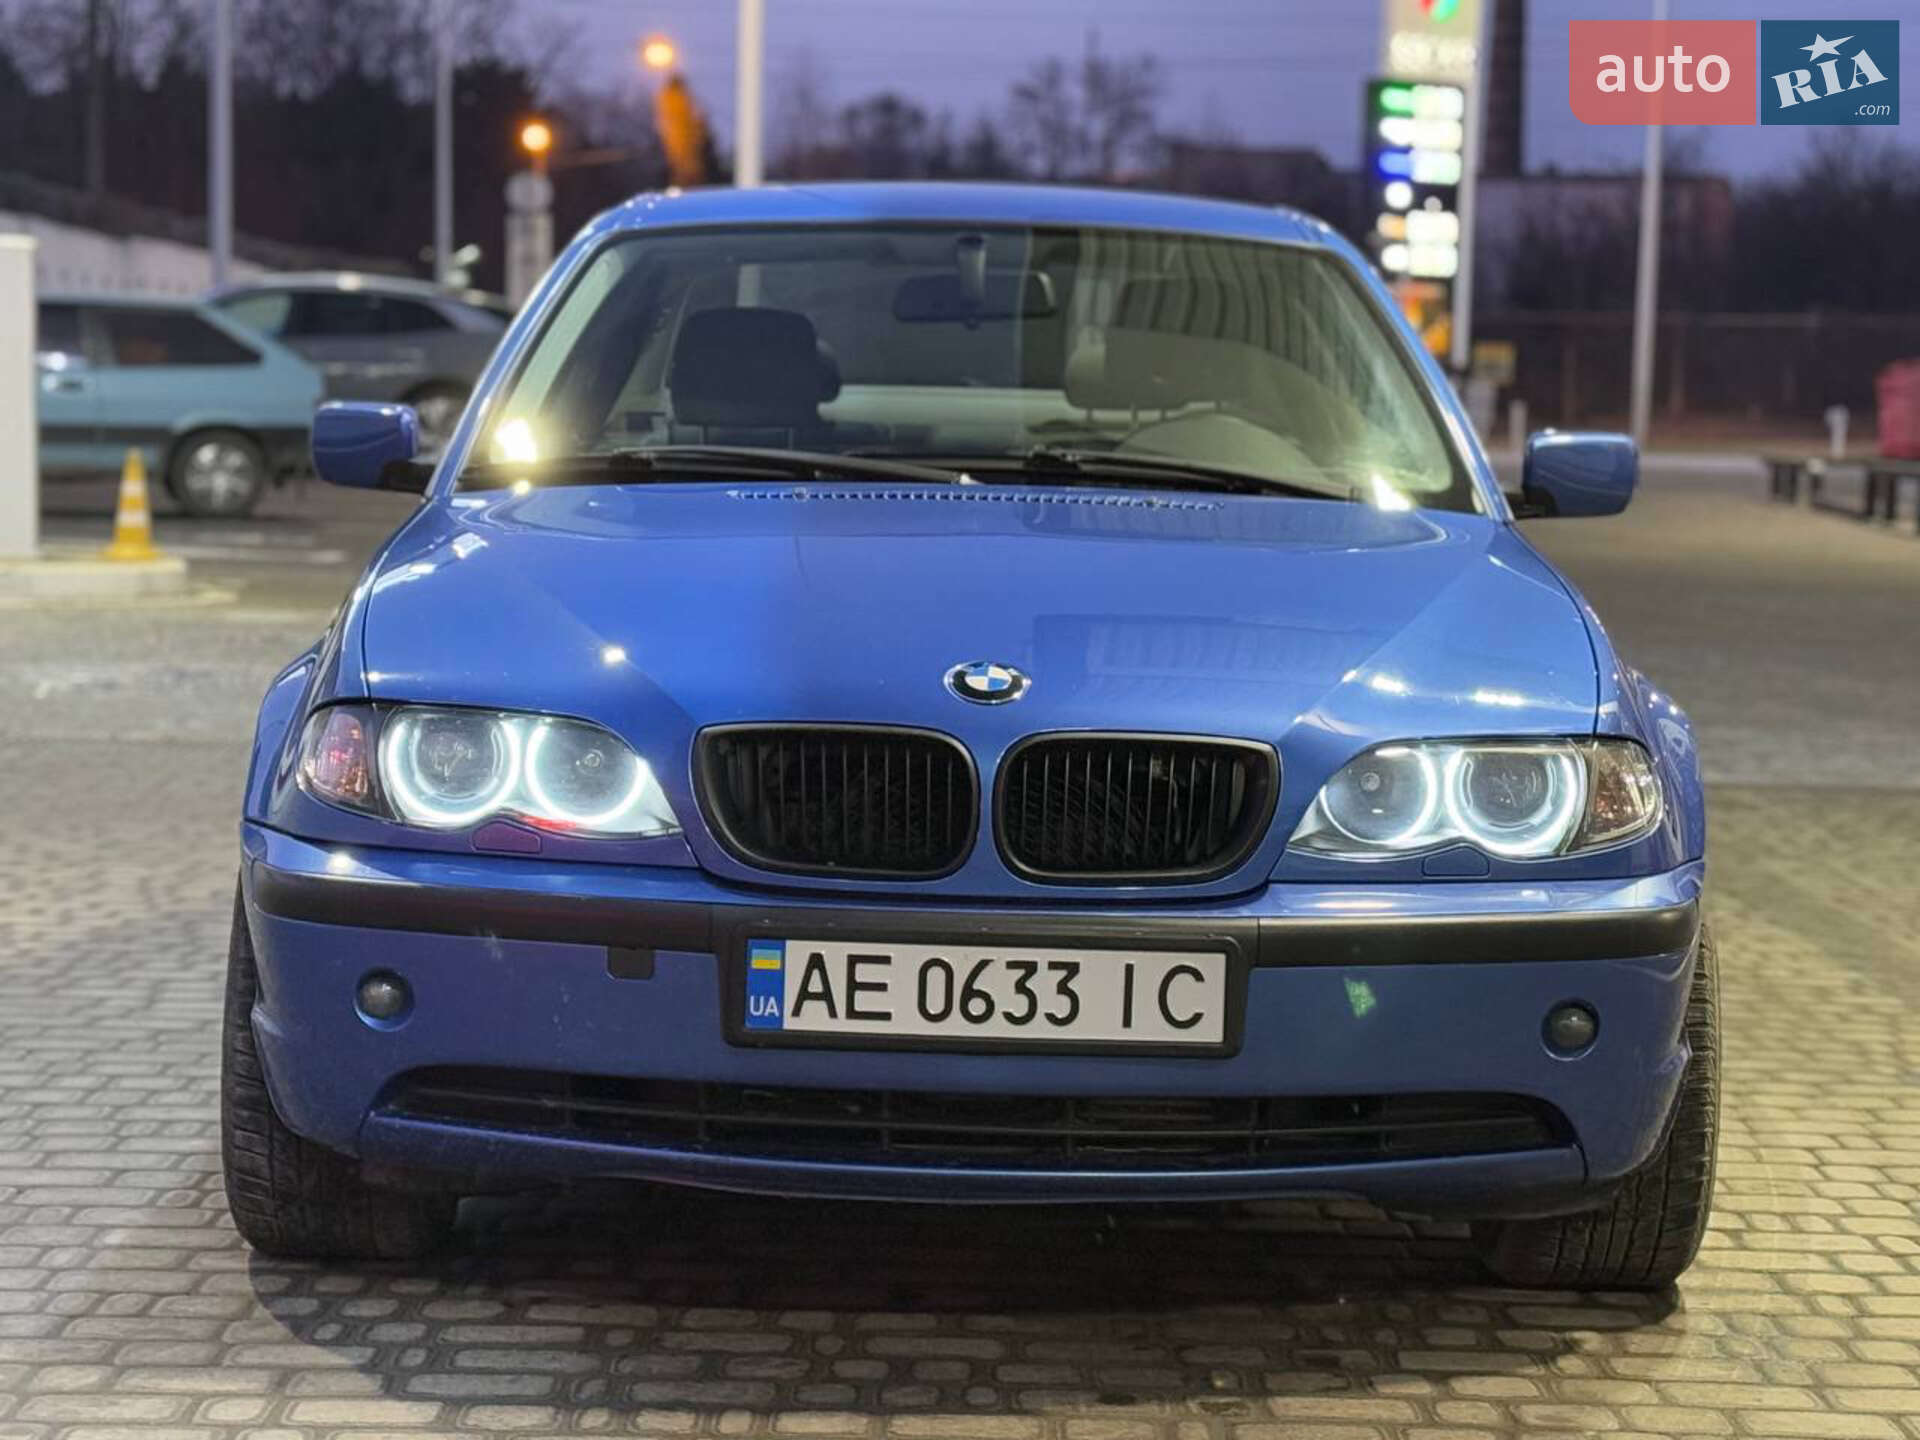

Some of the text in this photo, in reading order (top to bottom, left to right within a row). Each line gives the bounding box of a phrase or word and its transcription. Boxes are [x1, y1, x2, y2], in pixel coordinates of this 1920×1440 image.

[749, 997, 779, 1017] UA
[791, 952, 1205, 1029] AE 0633 IC
